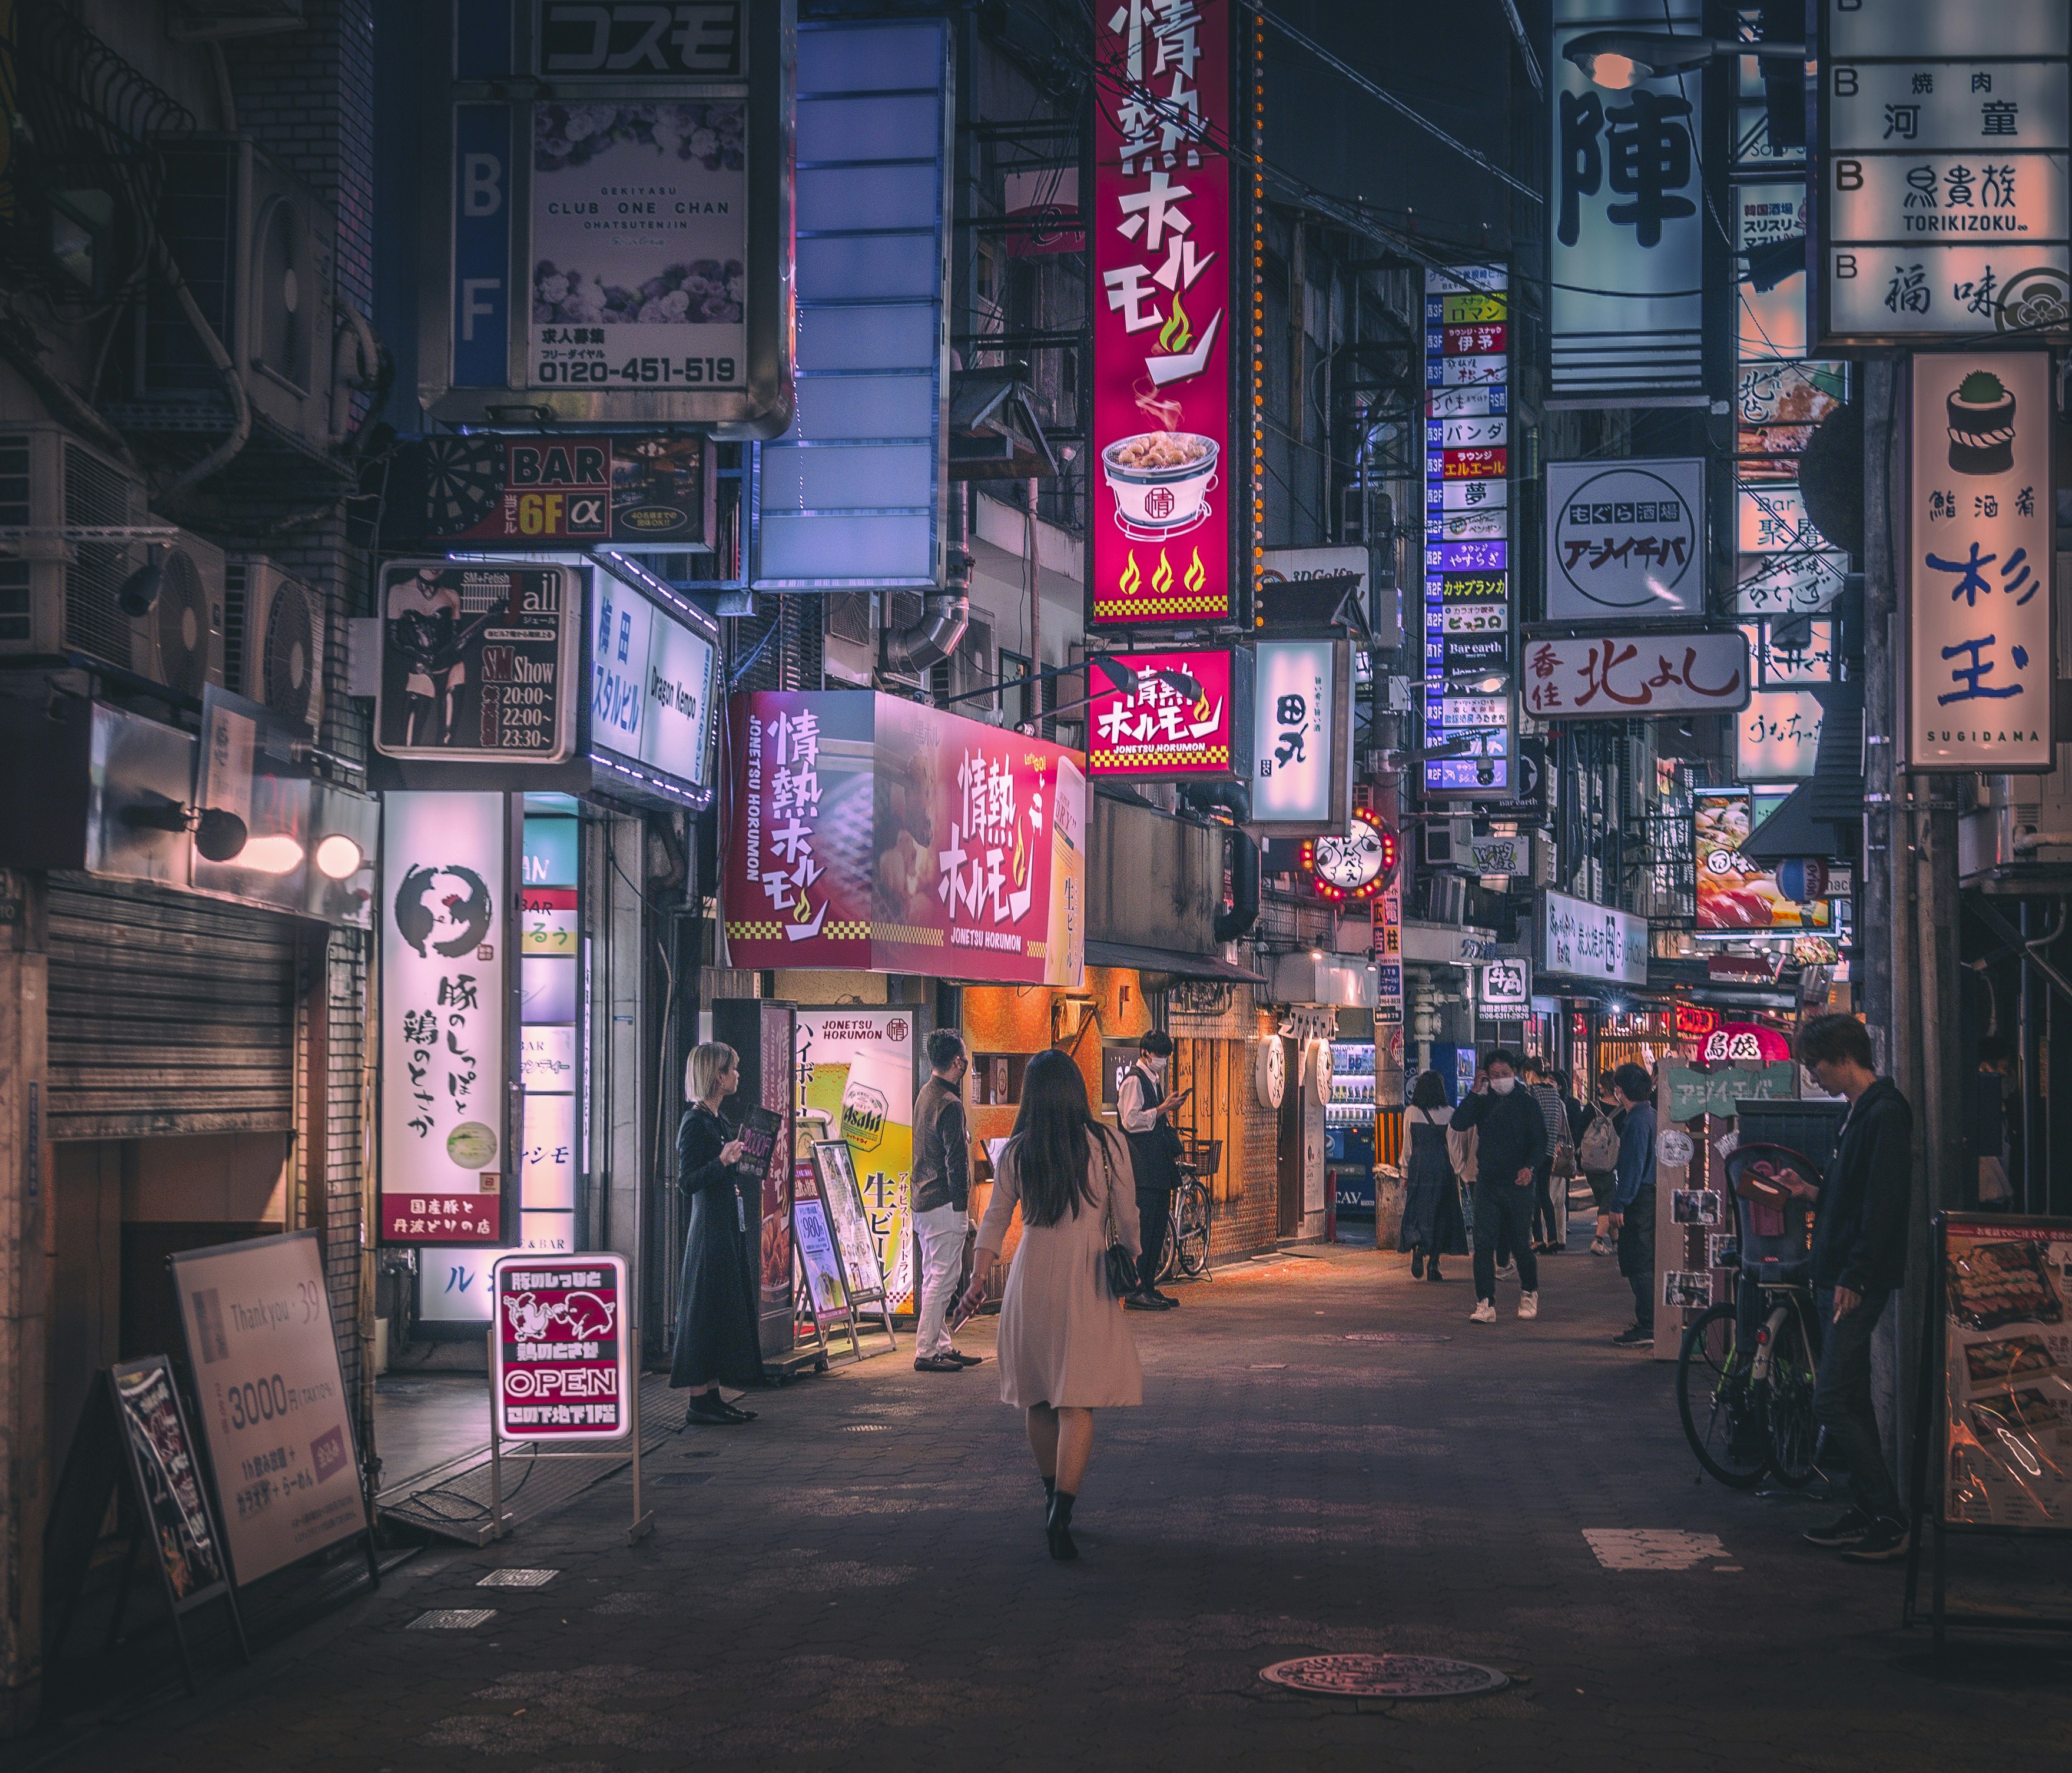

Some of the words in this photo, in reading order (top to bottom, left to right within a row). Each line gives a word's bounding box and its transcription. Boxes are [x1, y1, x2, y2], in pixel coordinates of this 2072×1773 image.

[548, 5, 734, 70] コスモ
[1834, 68, 1859, 97] B
[1911, 72, 1992, 94] 焼肉
[1883, 100, 2018, 140] 河童
[1557, 90, 1696, 248] 陣
[1836, 160, 1864, 191] B
[463, 153, 502, 217] B
[601, 187, 677, 195] GEKIYASU
[1103, 0, 1221, 388] 情熱ホルモン
[1902, 165, 2016, 208] 鳥貴族
[548, 202, 599, 214] CLUB
[618, 202, 656, 214] ONE
[675, 202, 728, 214] CHAN
[584, 221, 688, 229] OHATSUTENJIN
[1744, 218, 1792, 233] スリスリ
[1902, 215, 2016, 231] TORIKIZOKU
[1836, 255, 1858, 279] B
[1885, 264, 2006, 318] 福味
[1451, 306, 1500, 321] ロマン
[542, 328, 605, 344] 求人募集
[539, 357, 735, 383] 0120-451-519
[1447, 422, 1504, 441] パンダ
[512, 446, 606, 485] BAR
[1445, 461, 1506, 476] エルエール
[1465, 482, 1487, 505] 夢
[519, 493, 563, 535] 6F
[1571, 503, 1680, 523] もぐら酒場
[1449, 551, 1500, 568] やすらぎ
[463, 572, 510, 584] SM+Fetish
[1443, 578, 1506, 597] カサブランカ
[1925, 542, 2040, 707] 杉玉
[1450, 642, 1471, 654] Bar
[1472, 641, 1502, 654] earth
[514, 655, 555, 684] Show
[1574, 638, 1741, 707] 北よし
[651, 665, 675, 708] Dragon
[675, 680, 697, 721] Kempo
[1097, 695, 1223, 744] ホルモン
[1113, 744, 1155, 754] JONETSU
[1156, 742, 1205, 753] HORUMON
[1927, 731, 2040, 742] SUGIDAMA
[748, 714, 762, 791] JONETSU
[957, 746, 1017, 850] 情熱
[746, 793, 761, 882] HORUMON
[761, 708, 830, 942] 情熱ホルモン
[937, 821, 1036, 925] ホルモン
[1063, 877, 1075, 970] 生ビール
[950, 926, 985, 947] JONETSU
[985, 933, 1022, 953] HORUMON
[1488, 967, 1522, 993] 牛角
[822, 1020, 873, 1030] JONETSU
[824, 1030, 883, 1040] HORUMON
[844, 1103, 881, 1134] Asahi
[410, 1199, 475, 1215] 国産豚と
[393, 1218, 491, 1235] 丹波どりの店
[863, 1171, 898, 1282] 生ビール
[898, 1172, 910, 1284] アサヒスーパードライ
[511, 1271, 602, 1291] 豚のしっぽと
[229, 1298, 267, 1332] Thank
[517, 1341, 599, 1361] 鶏のとさか
[505, 1367, 617, 1398] OPEN
[228, 1373, 289, 1430] 3000
[506, 1404, 616, 1424] この下地下1階
